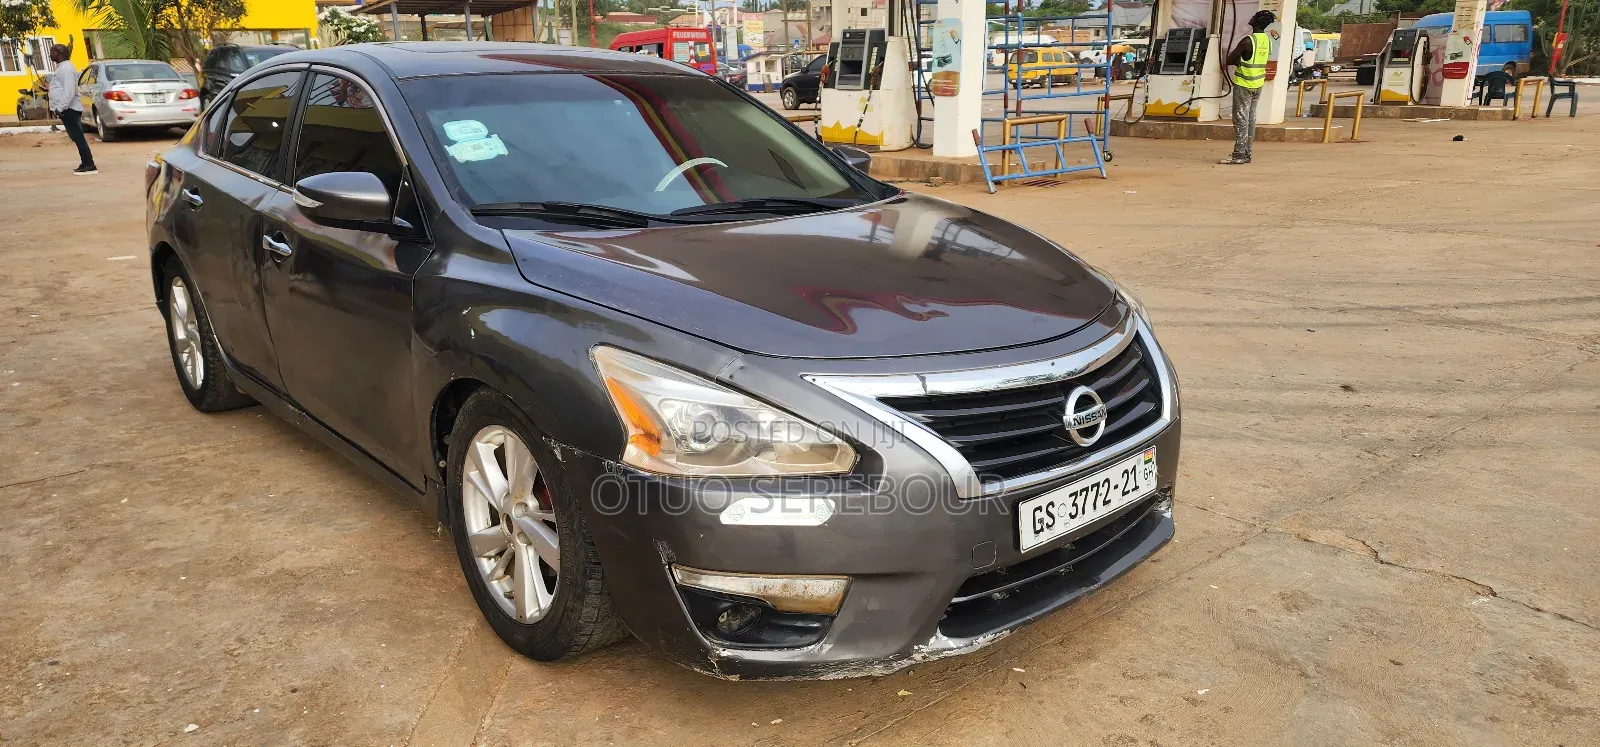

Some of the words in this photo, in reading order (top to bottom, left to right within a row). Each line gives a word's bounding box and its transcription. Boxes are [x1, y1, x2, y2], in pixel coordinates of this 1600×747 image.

[672, 31, 707, 39] FEUERWEHR
[1073, 408, 1105, 427] NISSAN
[1143, 466, 1154, 481] GH
[1032, 500, 1056, 535] GS
[1068, 464, 1140, 520] 3772-21
